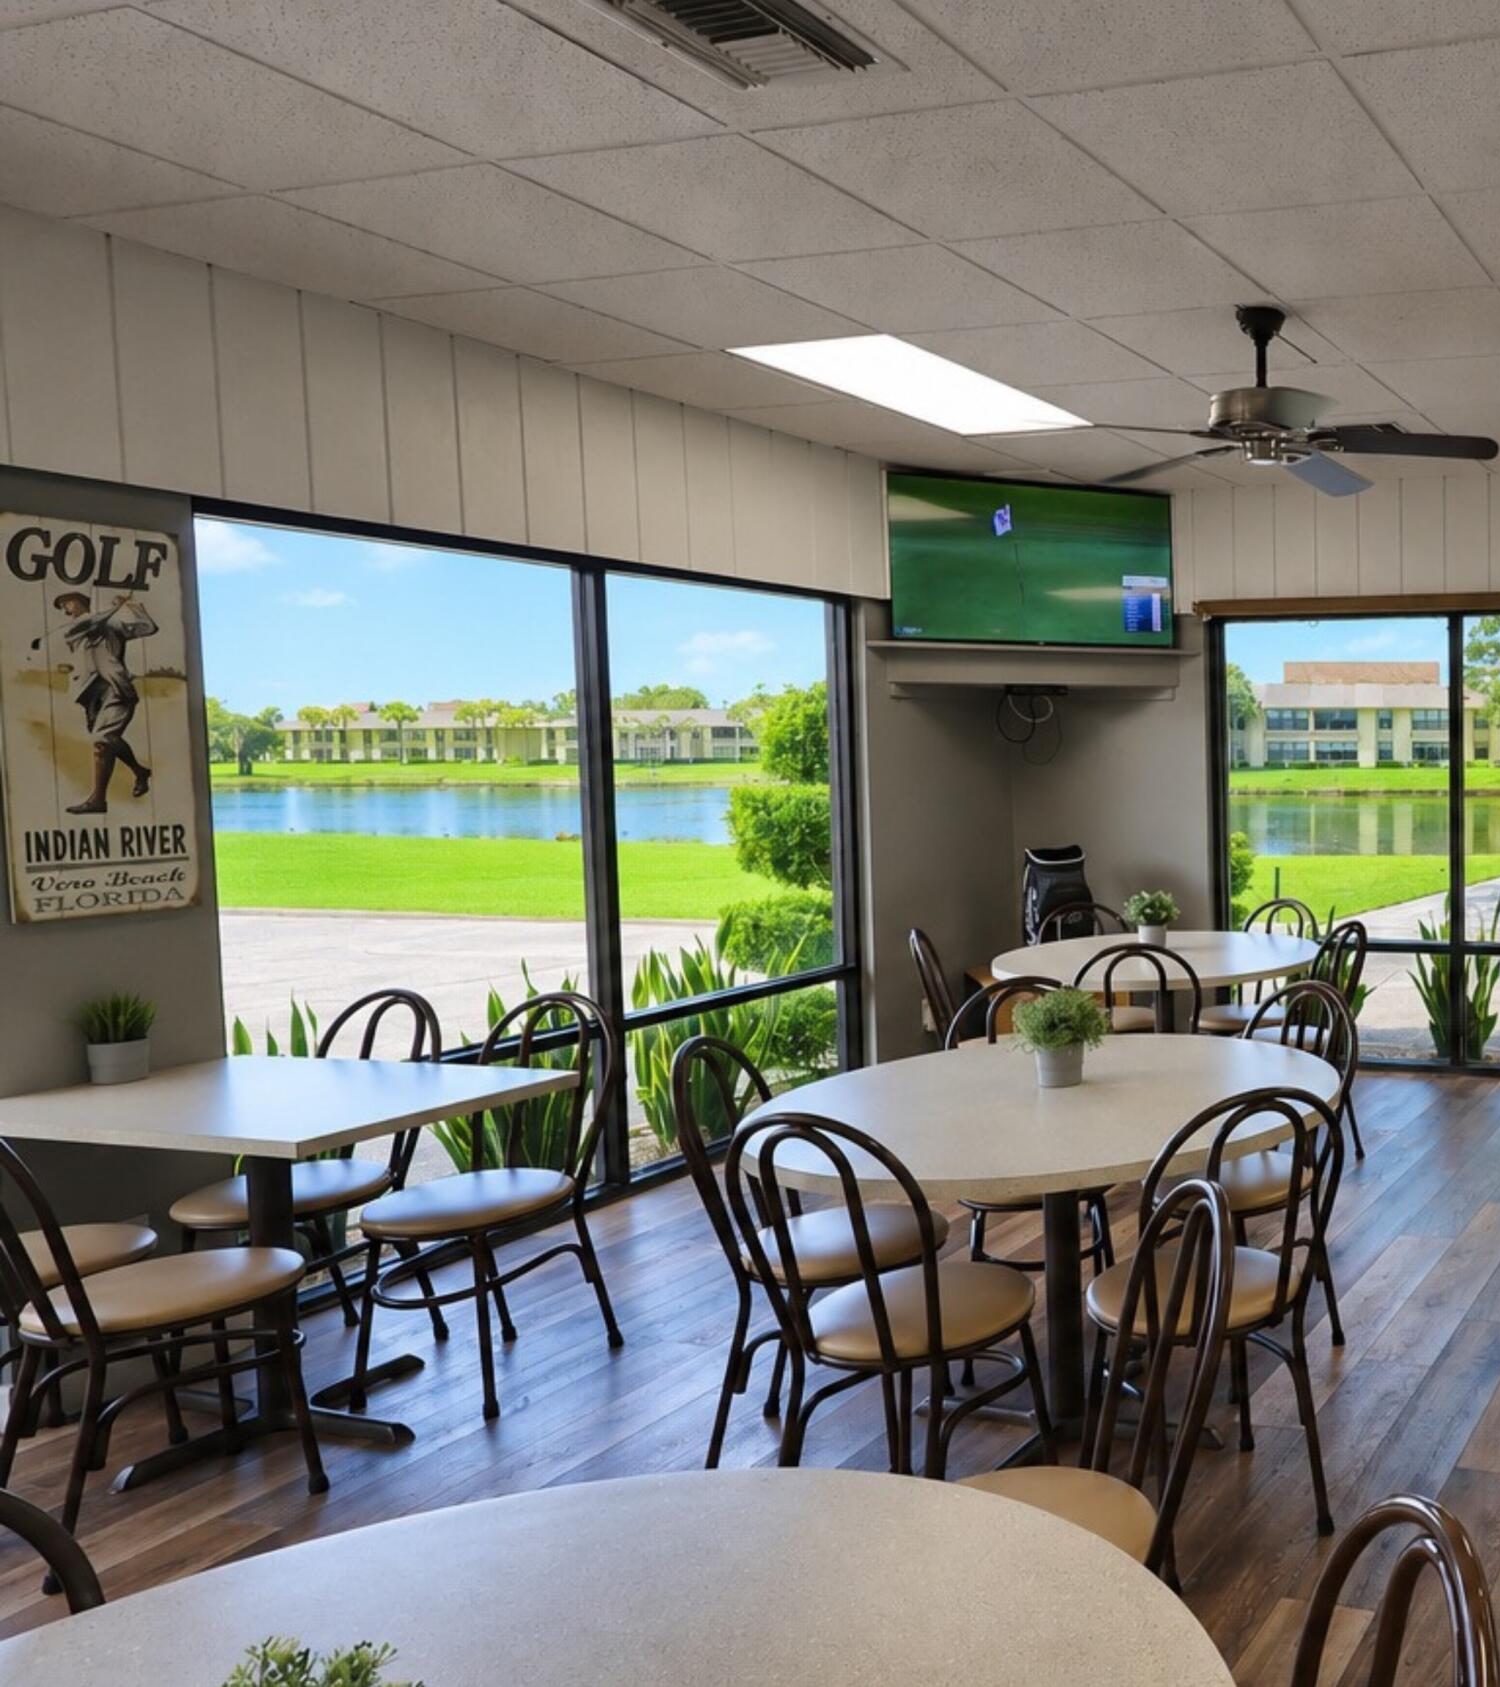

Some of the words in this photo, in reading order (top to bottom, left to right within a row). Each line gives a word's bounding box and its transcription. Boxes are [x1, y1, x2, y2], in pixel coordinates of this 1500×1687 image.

[6, 527, 168, 591] GOLF
[25, 828, 111, 863] INDIAN
[120, 824, 187, 858] RIVER
[31, 875, 97, 893] Vero
[104, 866, 187, 888] Beach
[34, 886, 185, 914] FLORIDA
